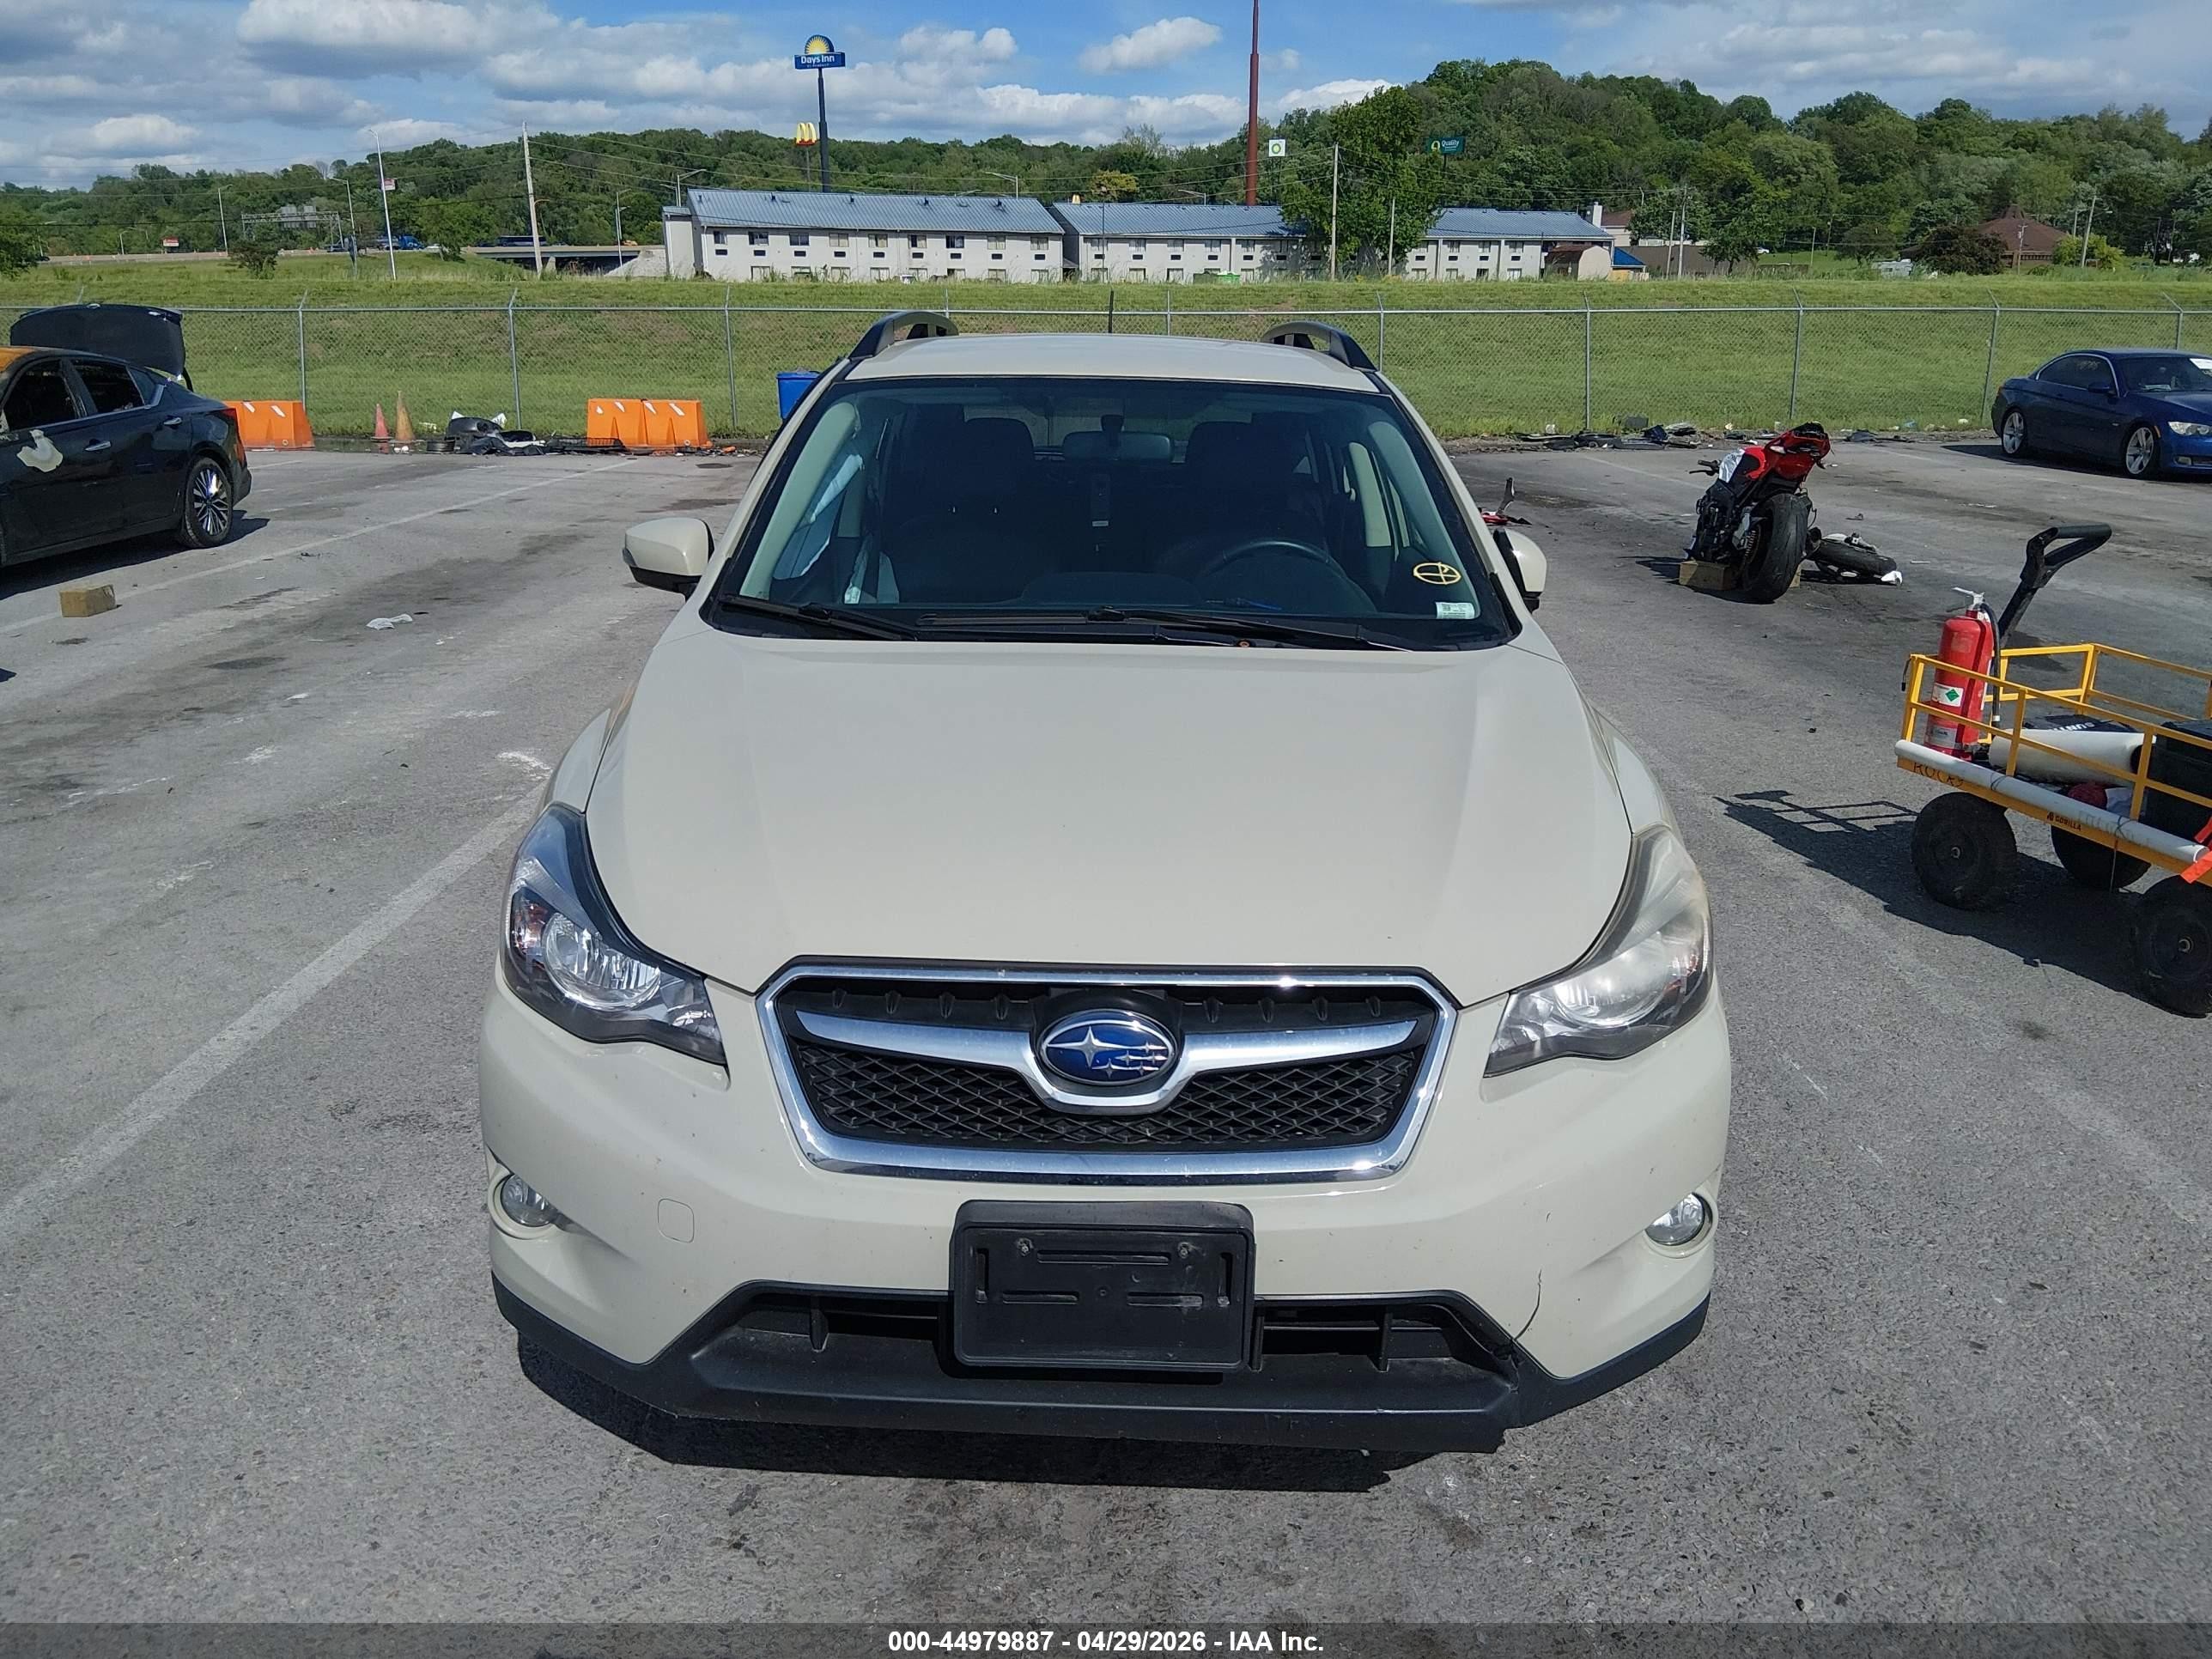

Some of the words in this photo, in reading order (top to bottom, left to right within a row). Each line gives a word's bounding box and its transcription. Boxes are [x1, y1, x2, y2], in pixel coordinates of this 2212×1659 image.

[800, 56, 820, 64] Days
[821, 54, 835, 63] Inn
[1442, 139, 1459, 148] Quality
[2055, 815, 2081, 831] GORILLA
